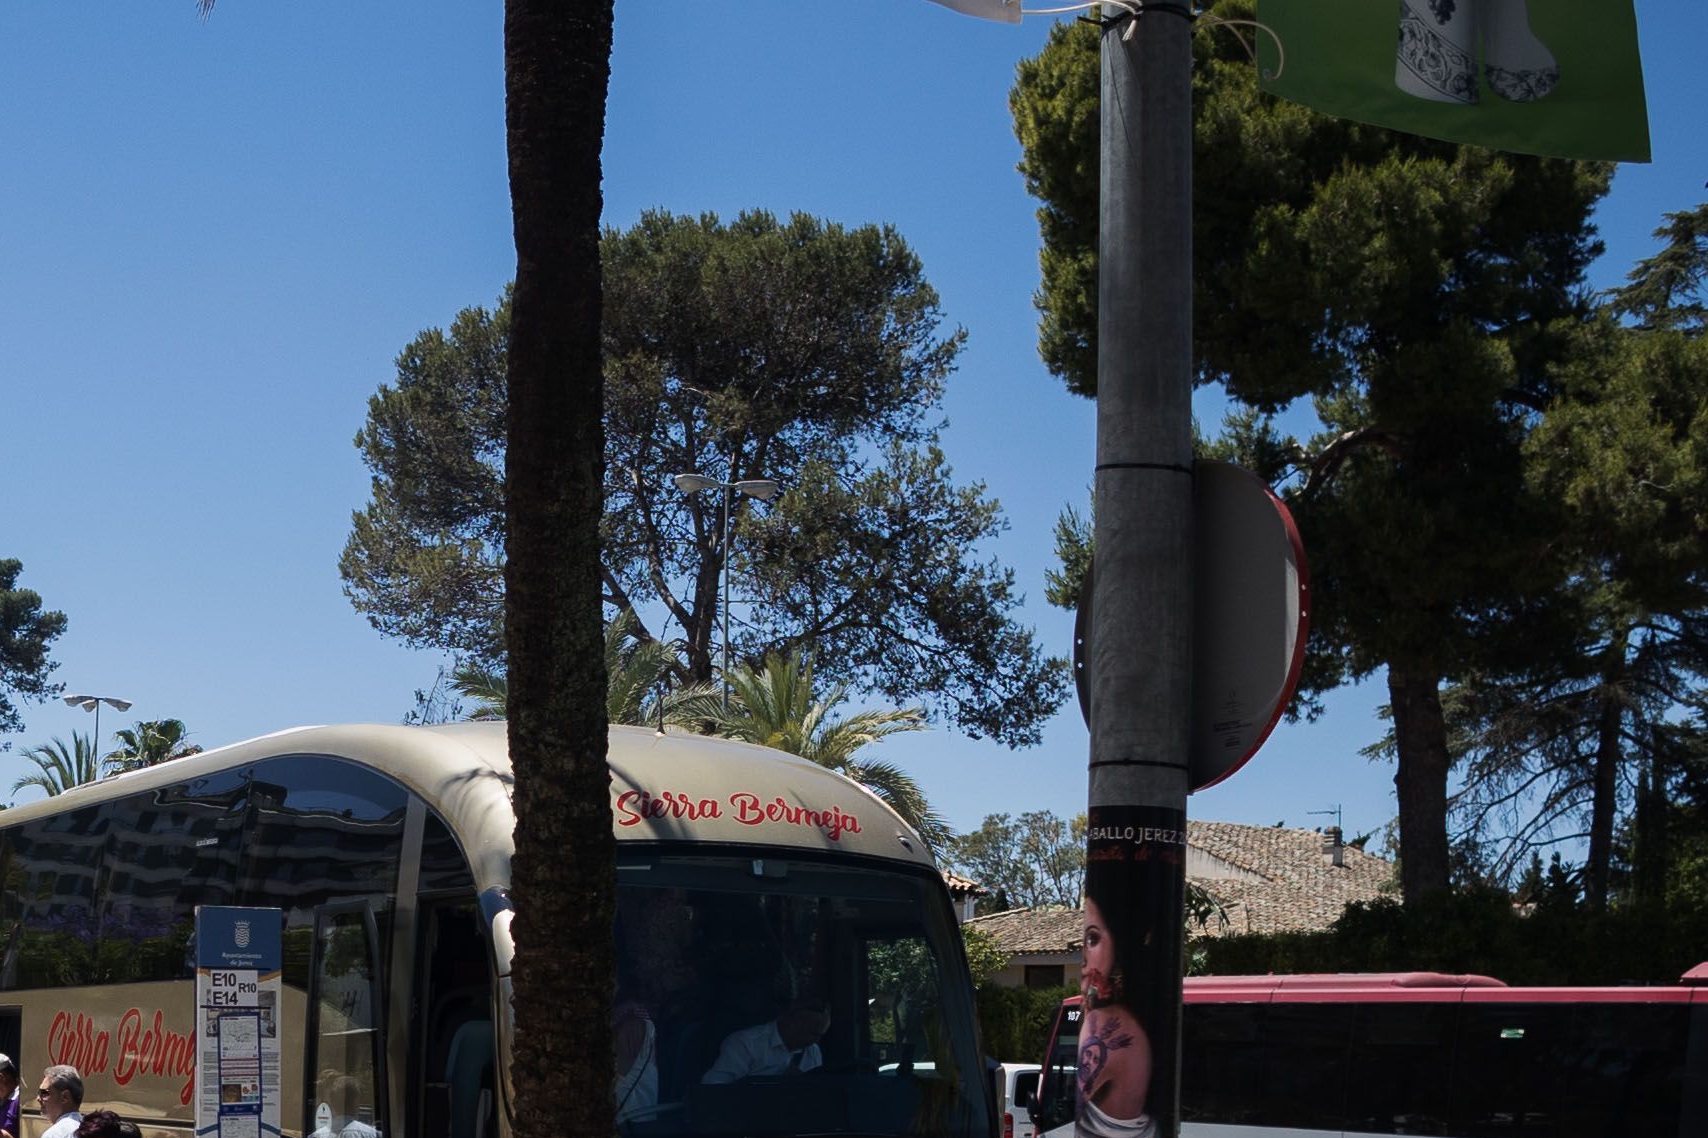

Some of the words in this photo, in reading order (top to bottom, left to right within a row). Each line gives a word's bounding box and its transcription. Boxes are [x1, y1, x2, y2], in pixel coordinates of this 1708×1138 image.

[616, 790, 723, 827] Sierra
[729, 792, 862, 842] Bermeja
[1134, 827, 1176, 845] JEREZ
[212, 973, 237, 987] E10
[238, 983, 257, 993] R10
[213, 991, 238, 1006] E14
[1067, 1011, 1081, 1021] 107
[48, 1011, 109, 1078] Sierra
